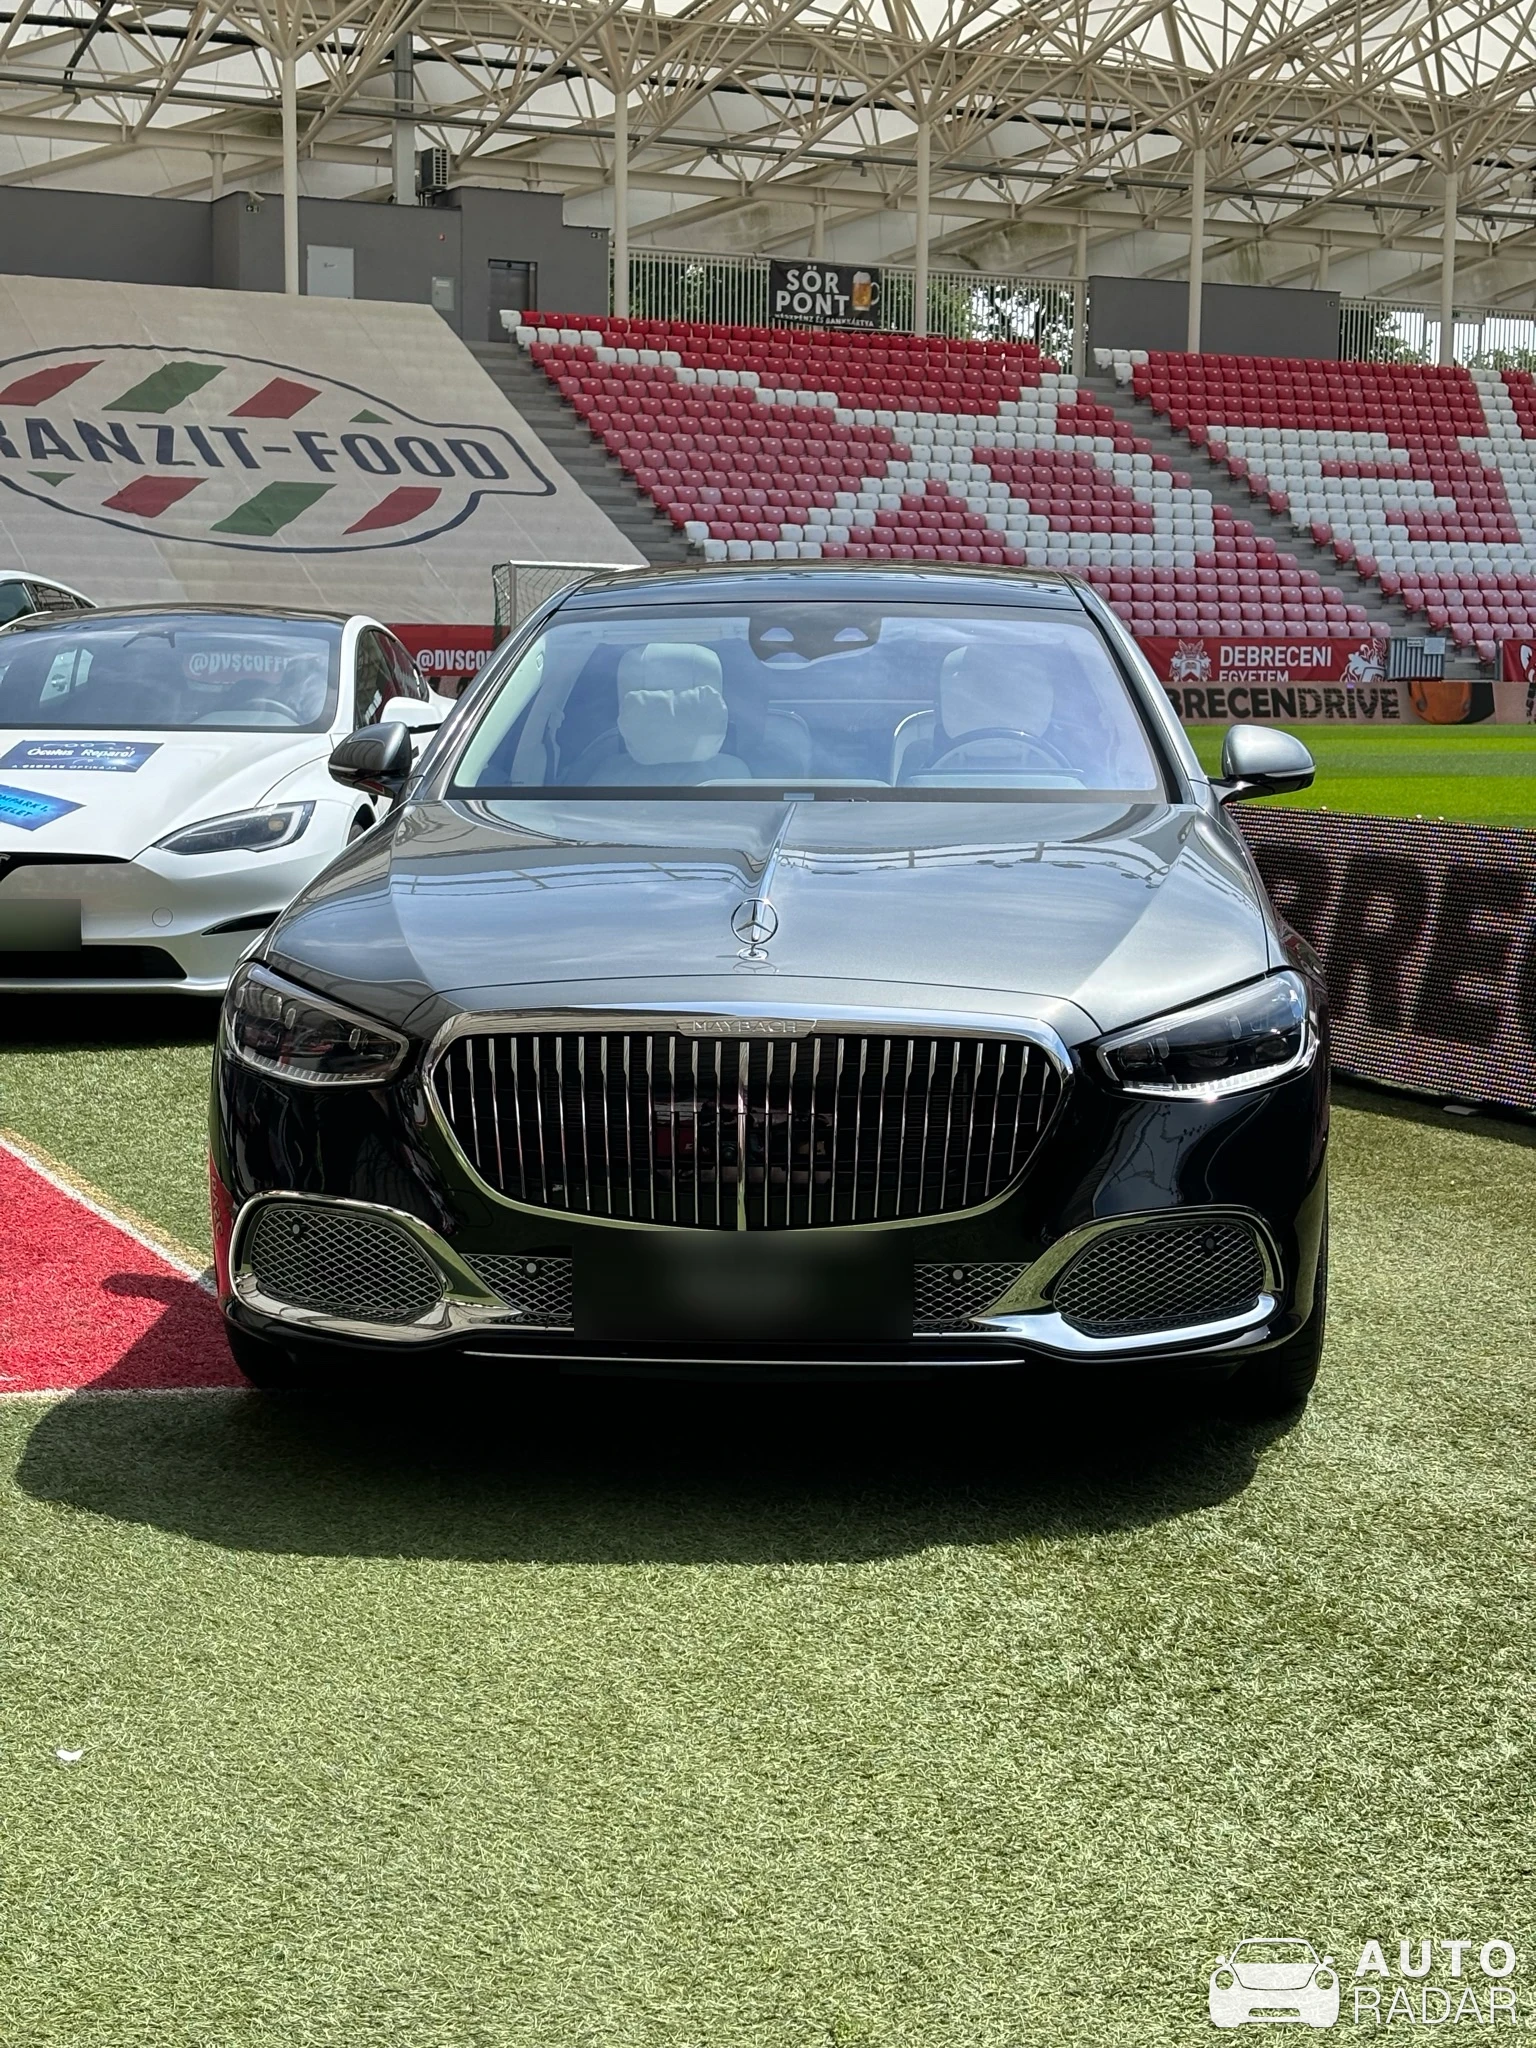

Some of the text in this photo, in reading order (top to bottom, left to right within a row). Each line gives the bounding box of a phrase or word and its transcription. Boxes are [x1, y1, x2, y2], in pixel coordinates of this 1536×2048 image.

[786, 265, 840, 294] SÖR
[776, 290, 850, 317] PONT
[1219, 645, 1332, 668] DEBRECENI
[692, 1019, 798, 1033] MAYBACH
